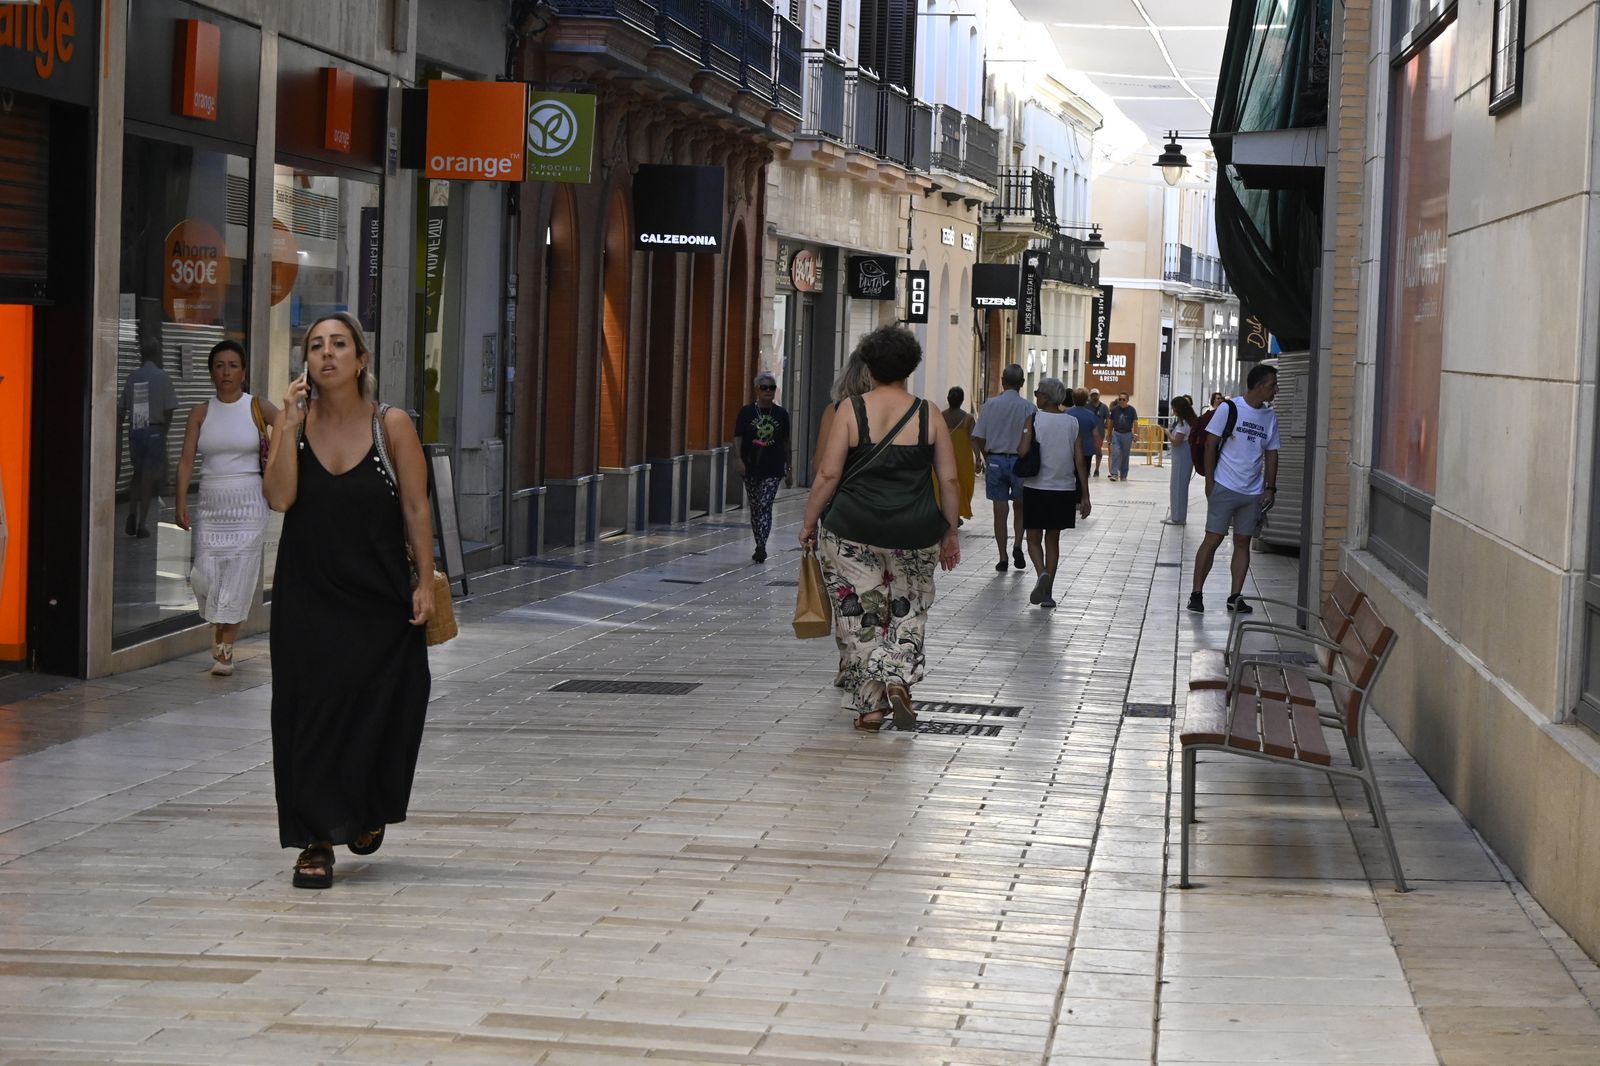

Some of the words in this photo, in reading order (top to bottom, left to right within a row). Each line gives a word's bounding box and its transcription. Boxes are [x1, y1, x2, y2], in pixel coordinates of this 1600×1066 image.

[0, 0, 76, 79] ange
[430, 155, 512, 177] orange
[172, 240, 217, 257] Ahorra
[640, 233, 717, 246] CALZEDONIA
[171, 259, 218, 285] 360€
